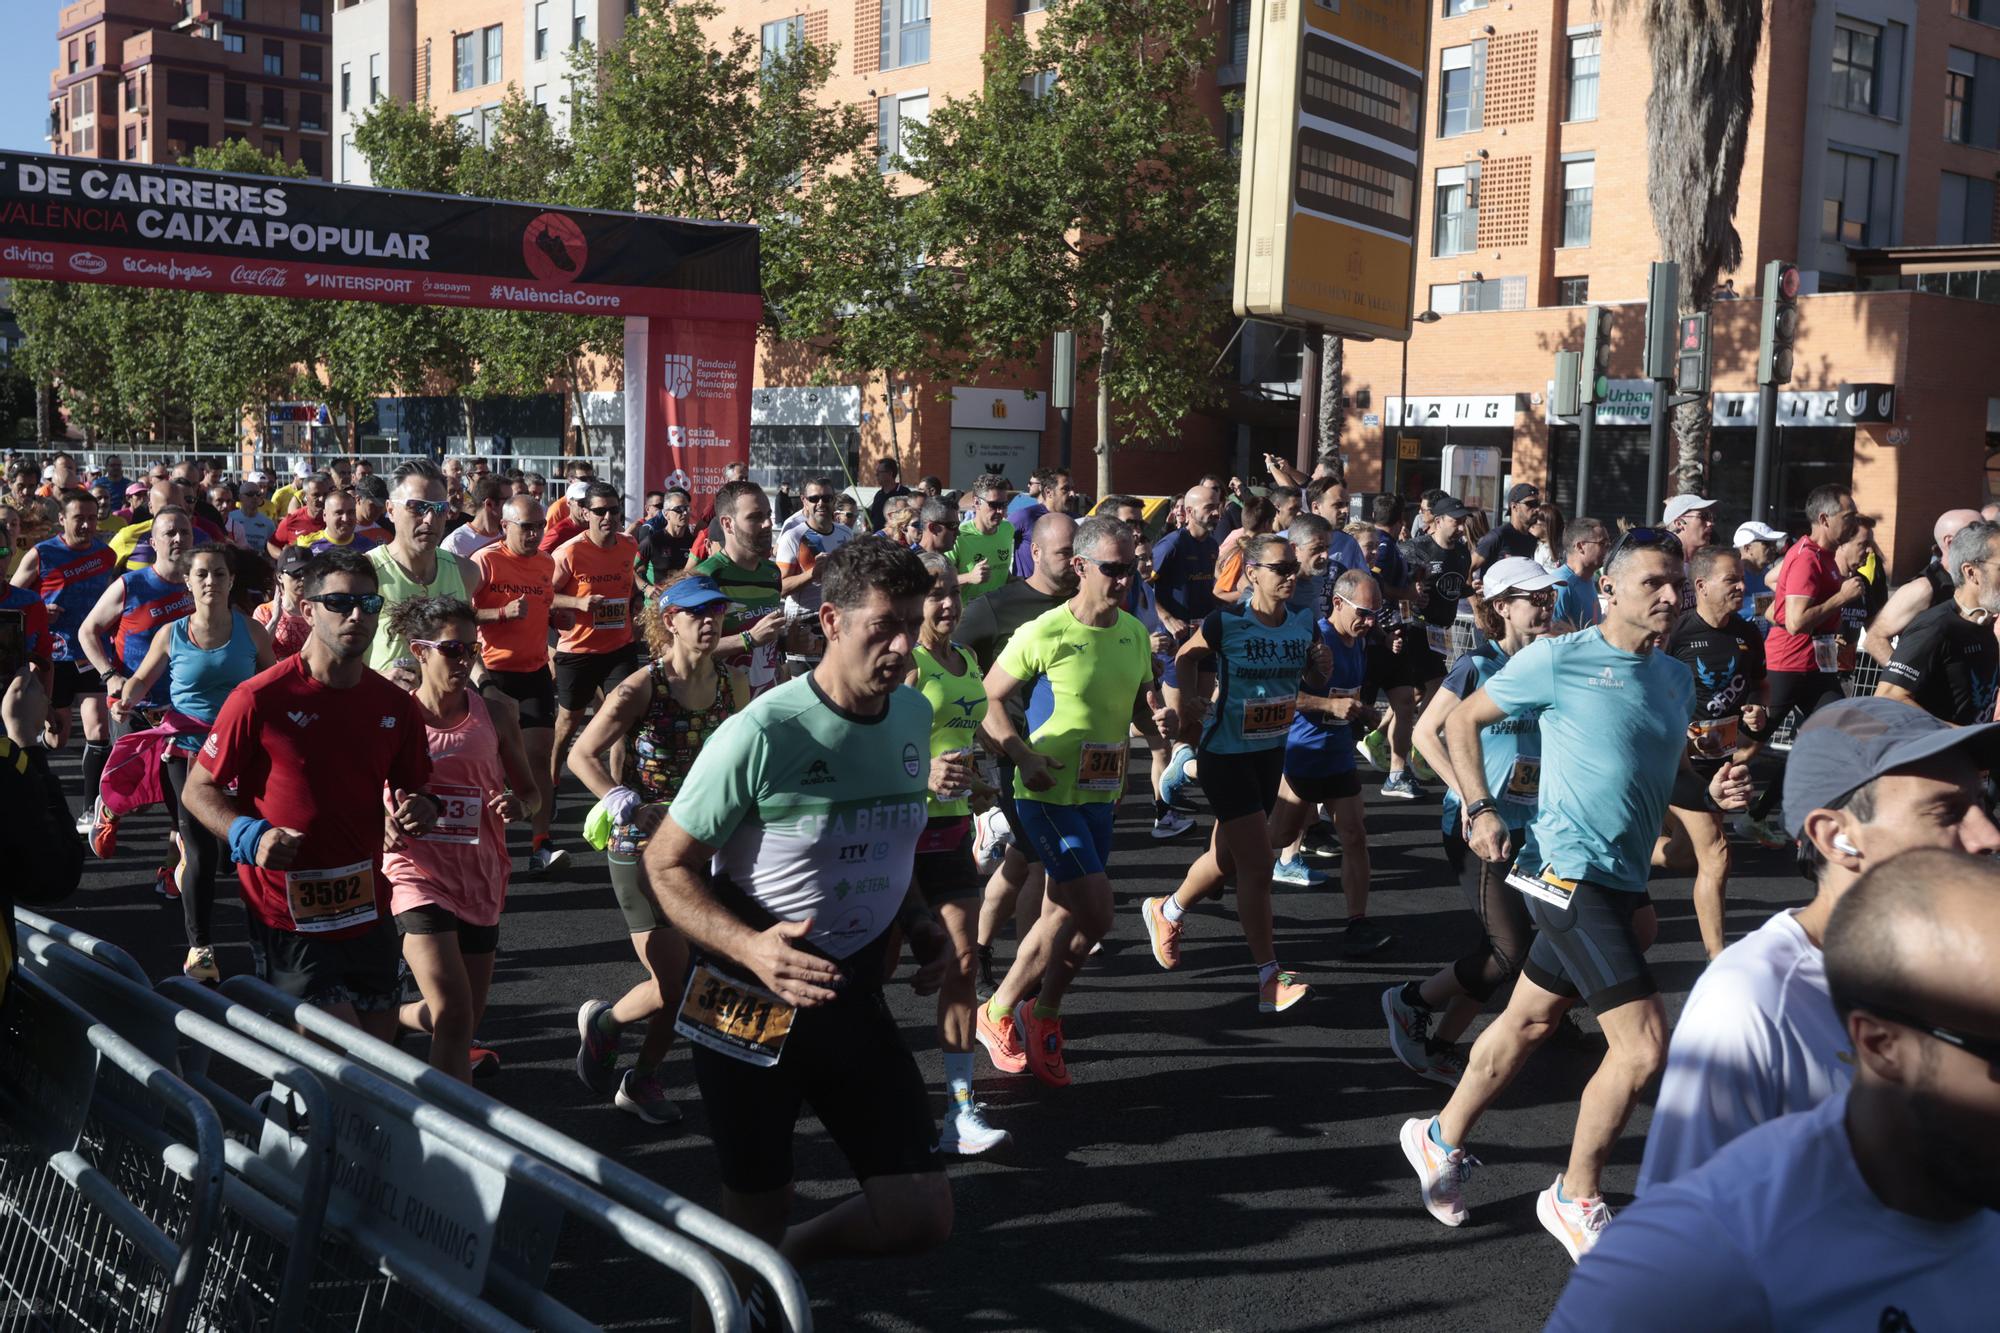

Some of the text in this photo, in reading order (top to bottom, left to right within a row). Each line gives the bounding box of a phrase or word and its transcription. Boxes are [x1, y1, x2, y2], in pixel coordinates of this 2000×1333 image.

[18, 163, 288, 217] DE CARRERES
[136, 209, 262, 247] CAIXA
[265, 221, 430, 260] POPULAR
[3, 246, 54, 263] divina
[137, 259, 168, 274] Corte
[320, 274, 413, 293] INTERSPORT
[433, 282, 471, 292] aspaym
[490, 285, 620, 307] #ValènciaCorre
[696, 359, 737, 369] Fundació
[696, 369, 738, 380] Esportiva
[696, 379, 738, 390] Municipal
[1608, 388, 1653, 402] Urban
[1597, 403, 1651, 419] unning
[688, 427, 716, 437] caixa
[688, 436, 731, 448] popular
[693, 475, 730, 485] TRINIDA
[693, 485, 720, 495] ALFON
[64, 557, 102, 578] Es posible
[579, 574, 622, 584] RUNNING
[490, 583, 544, 596] RUNNING
[150, 608, 163, 618] Es
[1254, 702, 1287, 723] 3715
[839, 843, 868, 860] ITV
[300, 876, 361, 907] 3582
[402, 1195, 479, 1270] RUNNING
